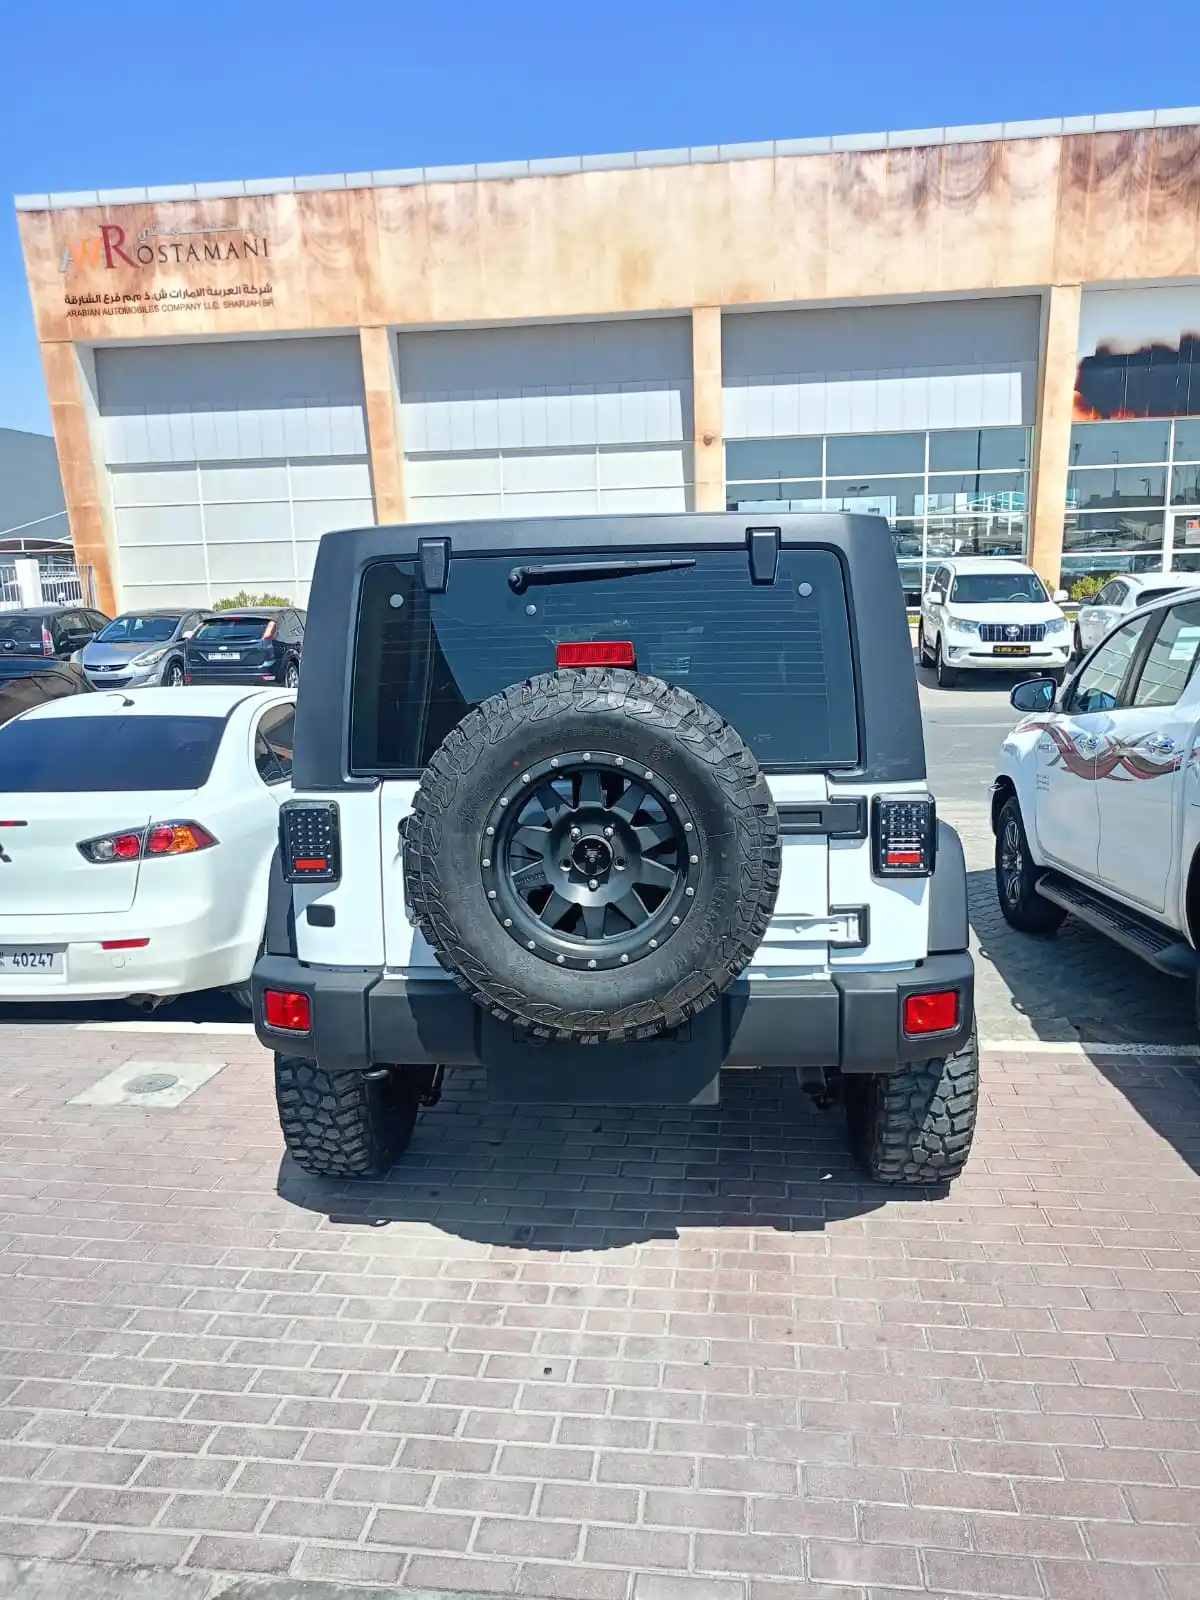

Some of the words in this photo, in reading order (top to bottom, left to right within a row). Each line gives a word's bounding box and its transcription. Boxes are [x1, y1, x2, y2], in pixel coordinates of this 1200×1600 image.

[243, 282, 273, 295] شركة
[66, 307, 101, 318] ARABIAN
[102, 304, 160, 316] AUTOMOBILES
[161, 302, 202, 313] COMPANY
[12, 952, 54, 968] 40247
